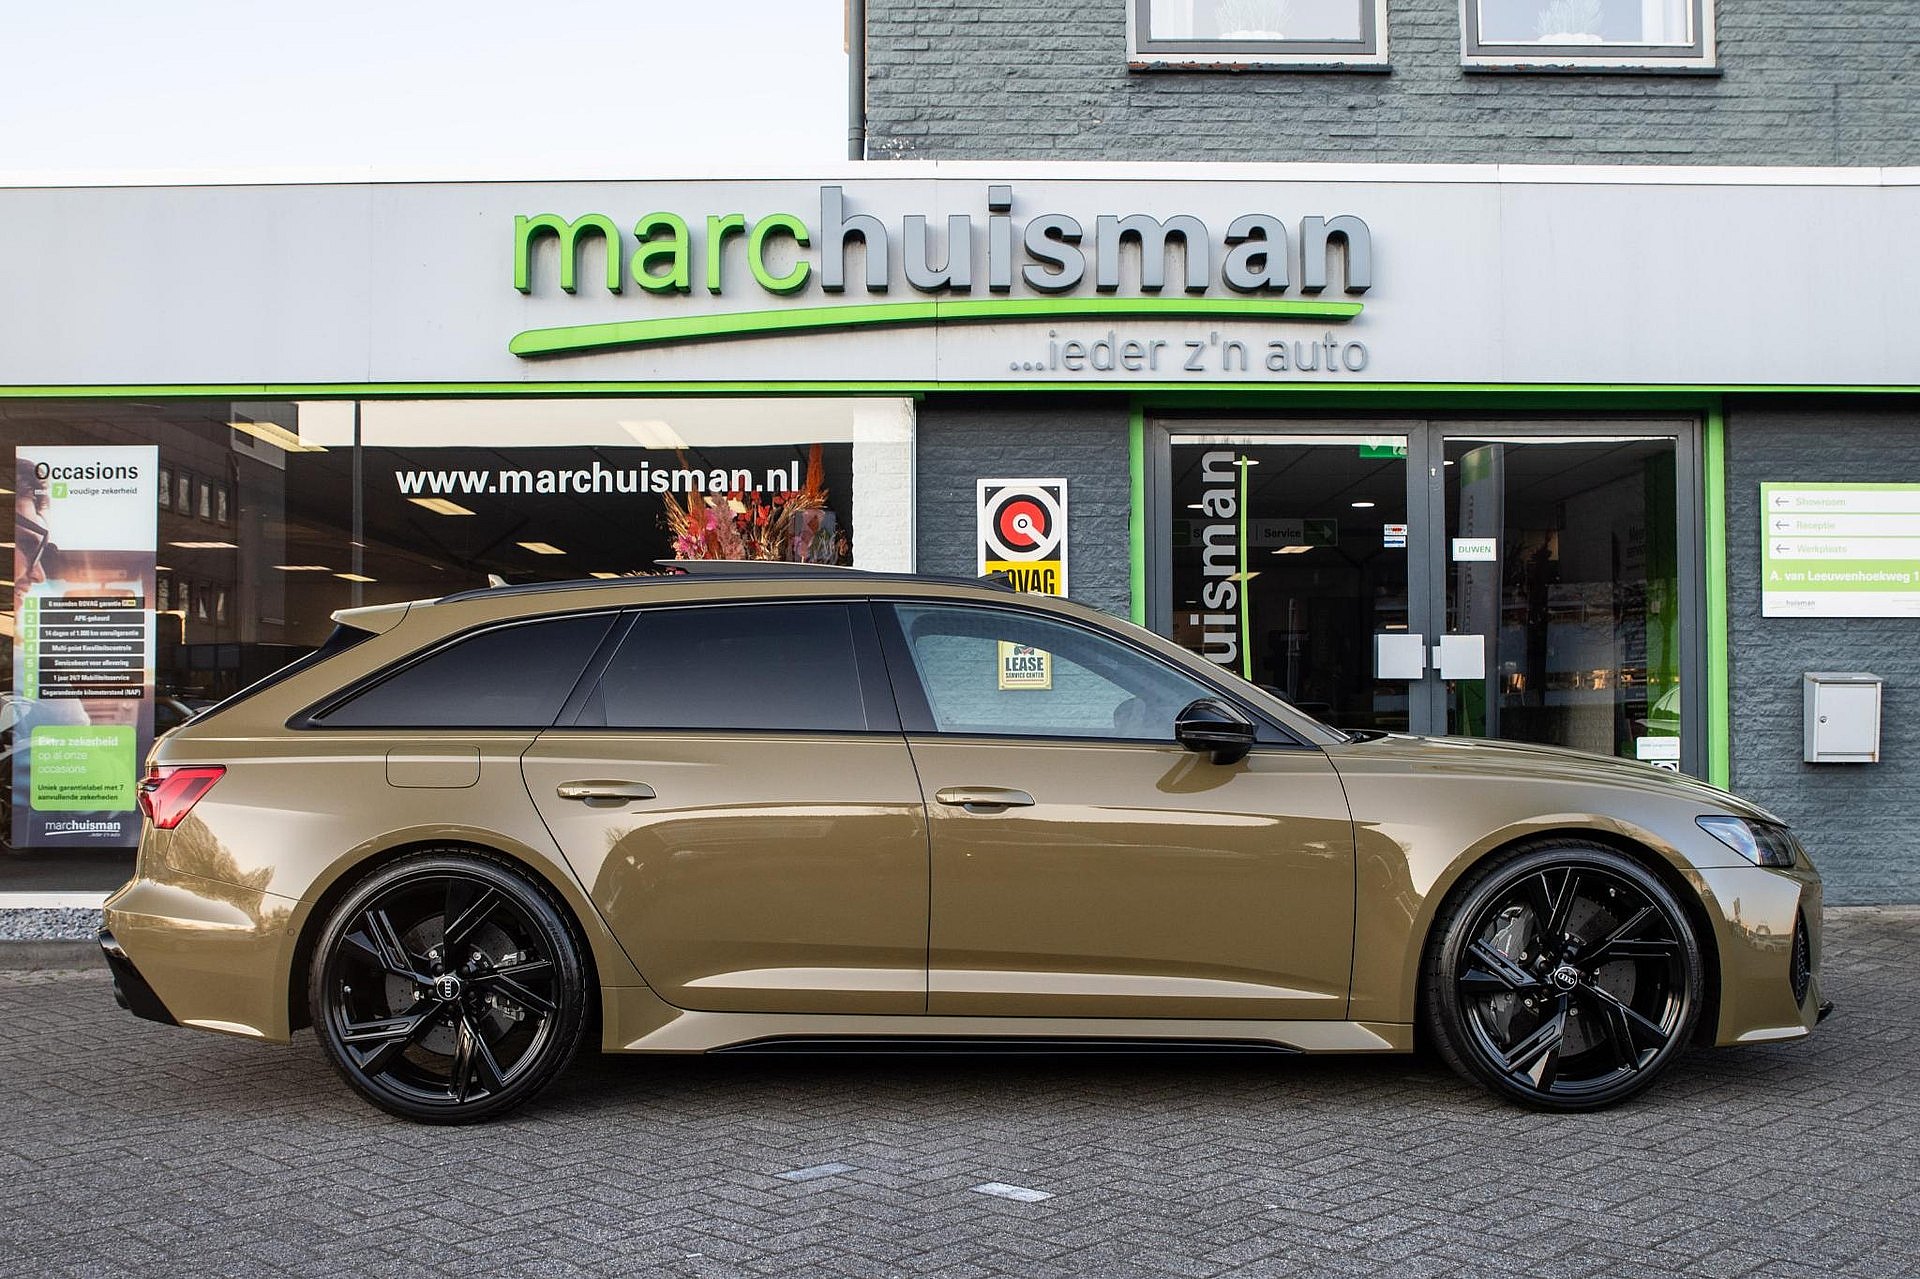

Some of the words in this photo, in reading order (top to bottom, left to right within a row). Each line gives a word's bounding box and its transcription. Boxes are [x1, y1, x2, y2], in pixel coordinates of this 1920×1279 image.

[514, 185, 1371, 295] marchuisman
[1183, 331, 1247, 372] z'n
[1265, 330, 1369, 372] auto
[35, 462, 139, 480] Occasions
[395, 461, 800, 494] www.marchuisman.nl
[68, 487, 100, 496] voudige
[101, 487, 138, 495] zekerheid
[1264, 527, 1301, 539] Service
[1458, 545, 1491, 554] DUWEN
[992, 569, 1055, 595] OVAG
[1770, 570, 1782, 581] A.
[1785, 572, 1805, 581] van
[1005, 657, 1044, 671] LEASE
[68, 736, 119, 746] zekerheid
[45, 820, 121, 830] marchuisman
